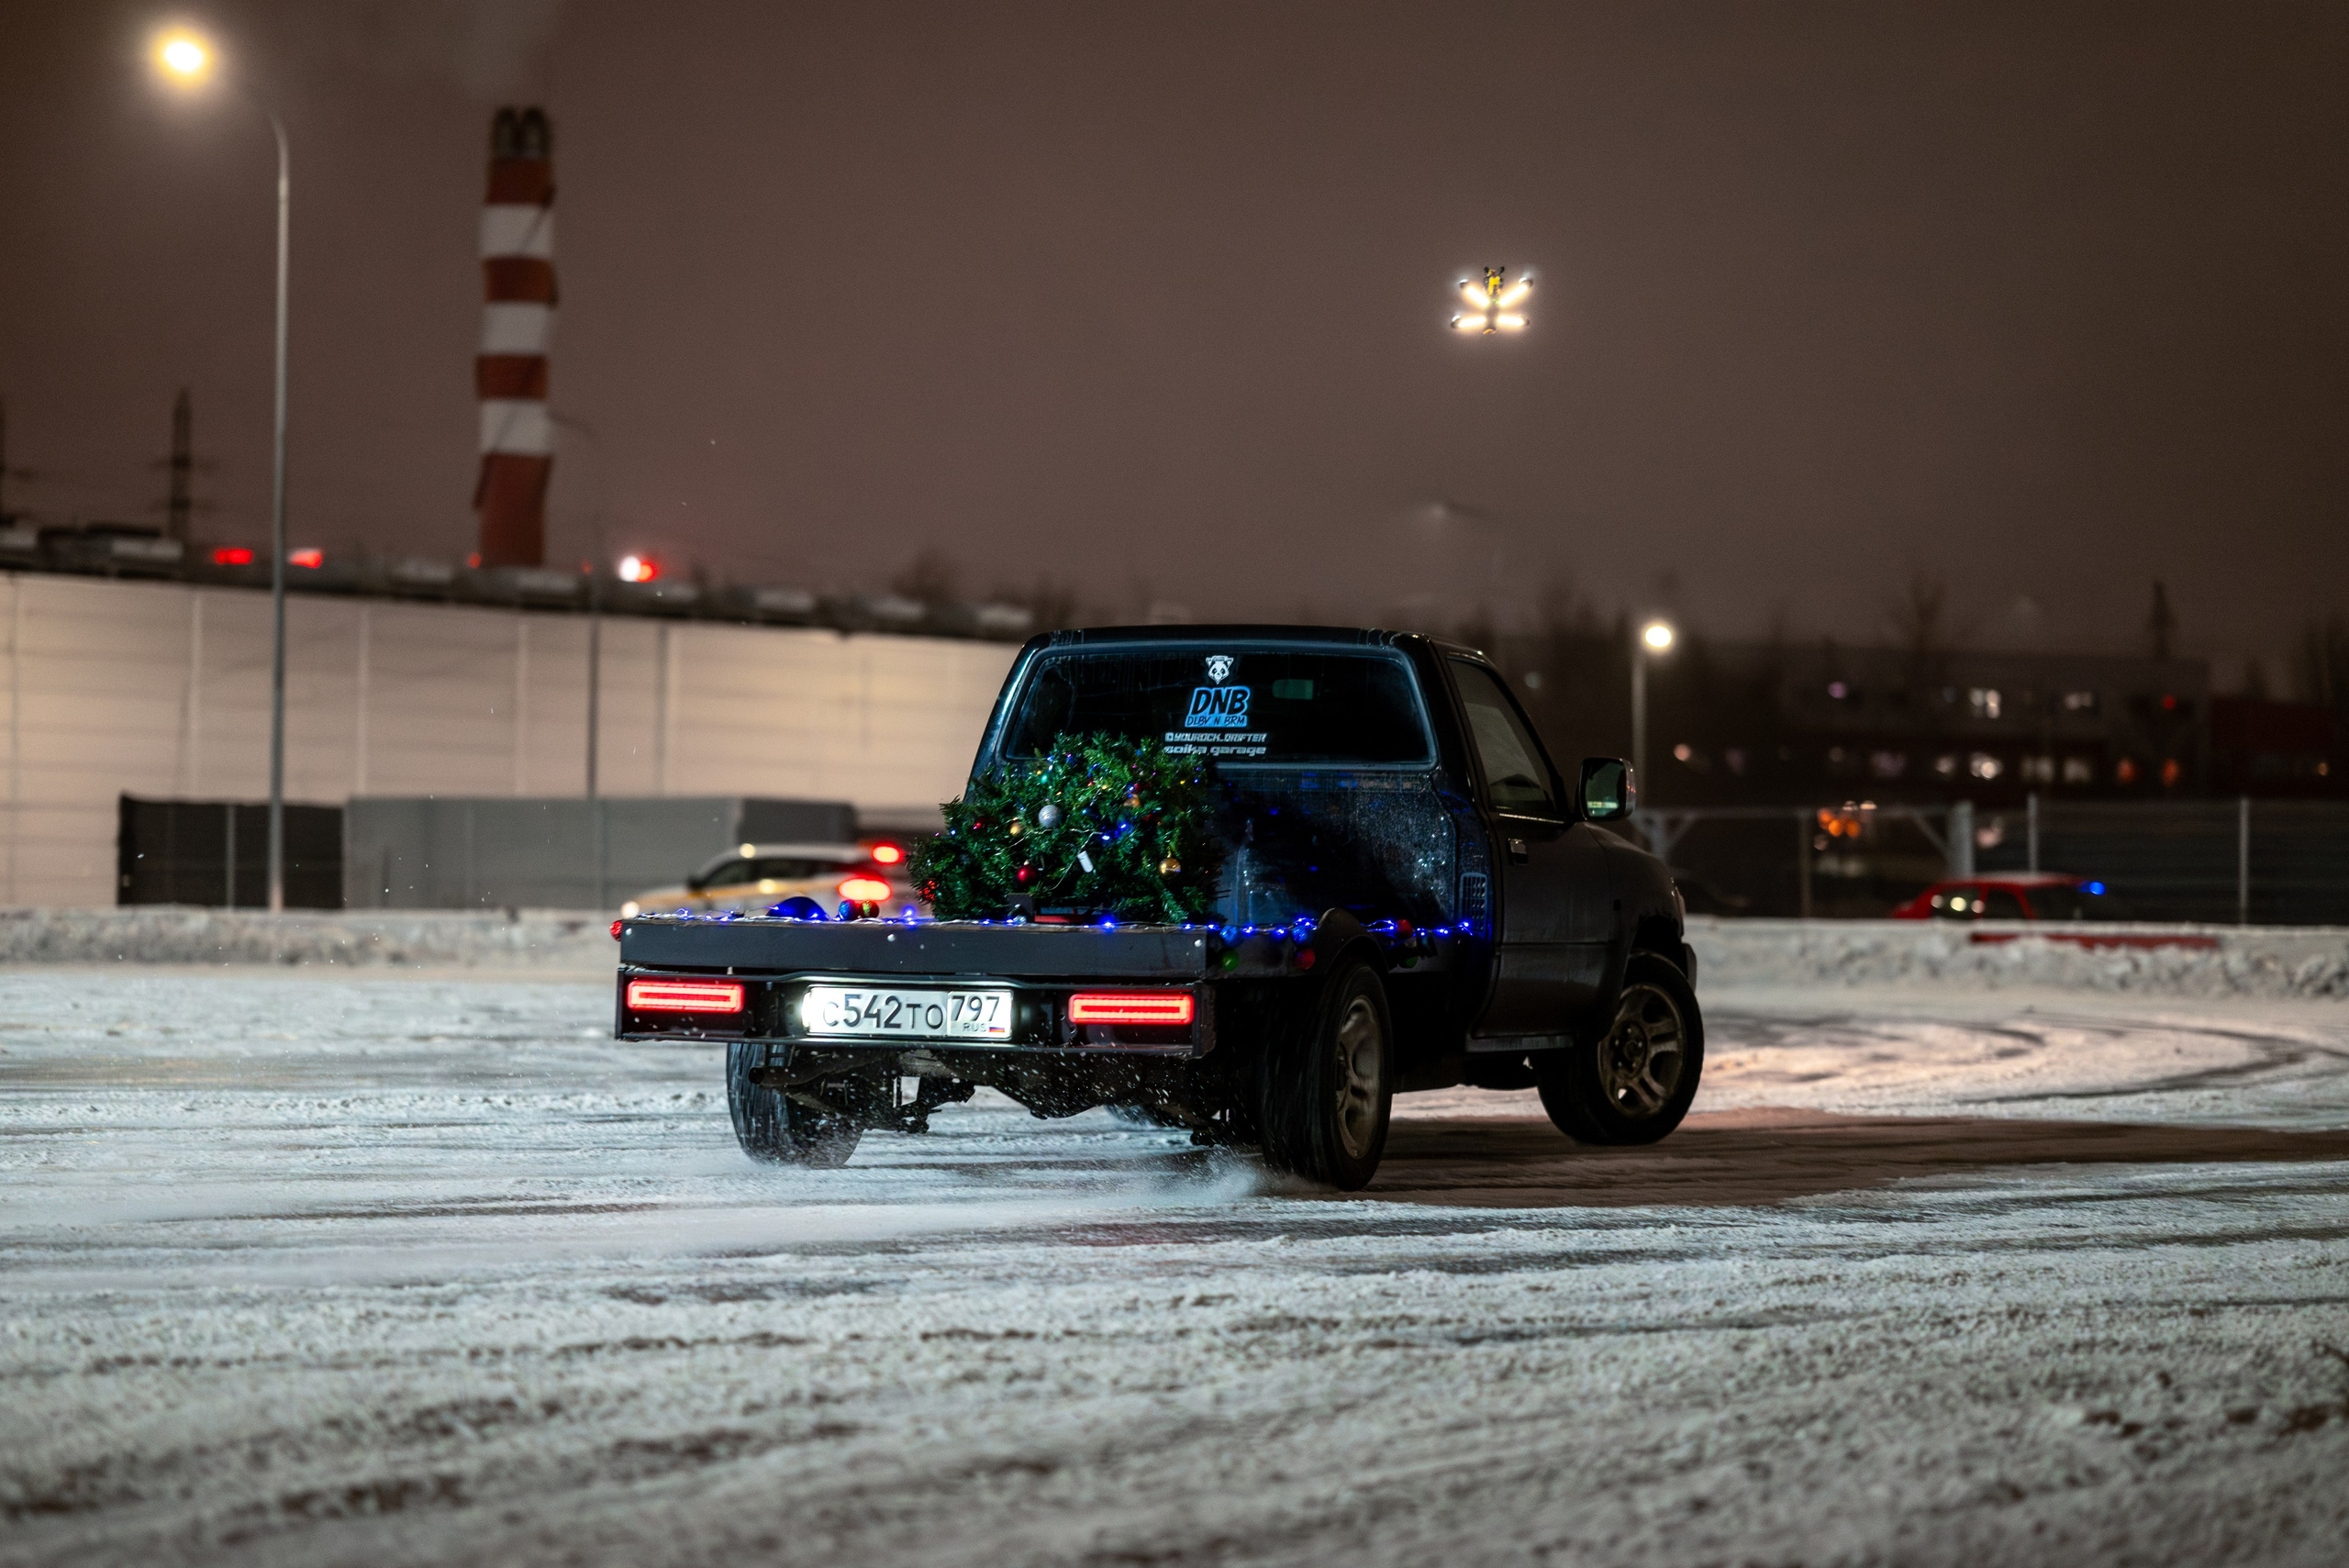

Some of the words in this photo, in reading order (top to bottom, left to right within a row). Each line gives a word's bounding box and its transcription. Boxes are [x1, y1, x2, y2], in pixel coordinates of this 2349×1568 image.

[1191, 688, 1249, 715] DNB
[1214, 717, 1220, 725] N
[1210, 746, 1266, 756] garage
[952, 995, 1000, 1022] 797
[963, 1022, 986, 1032] RUS
